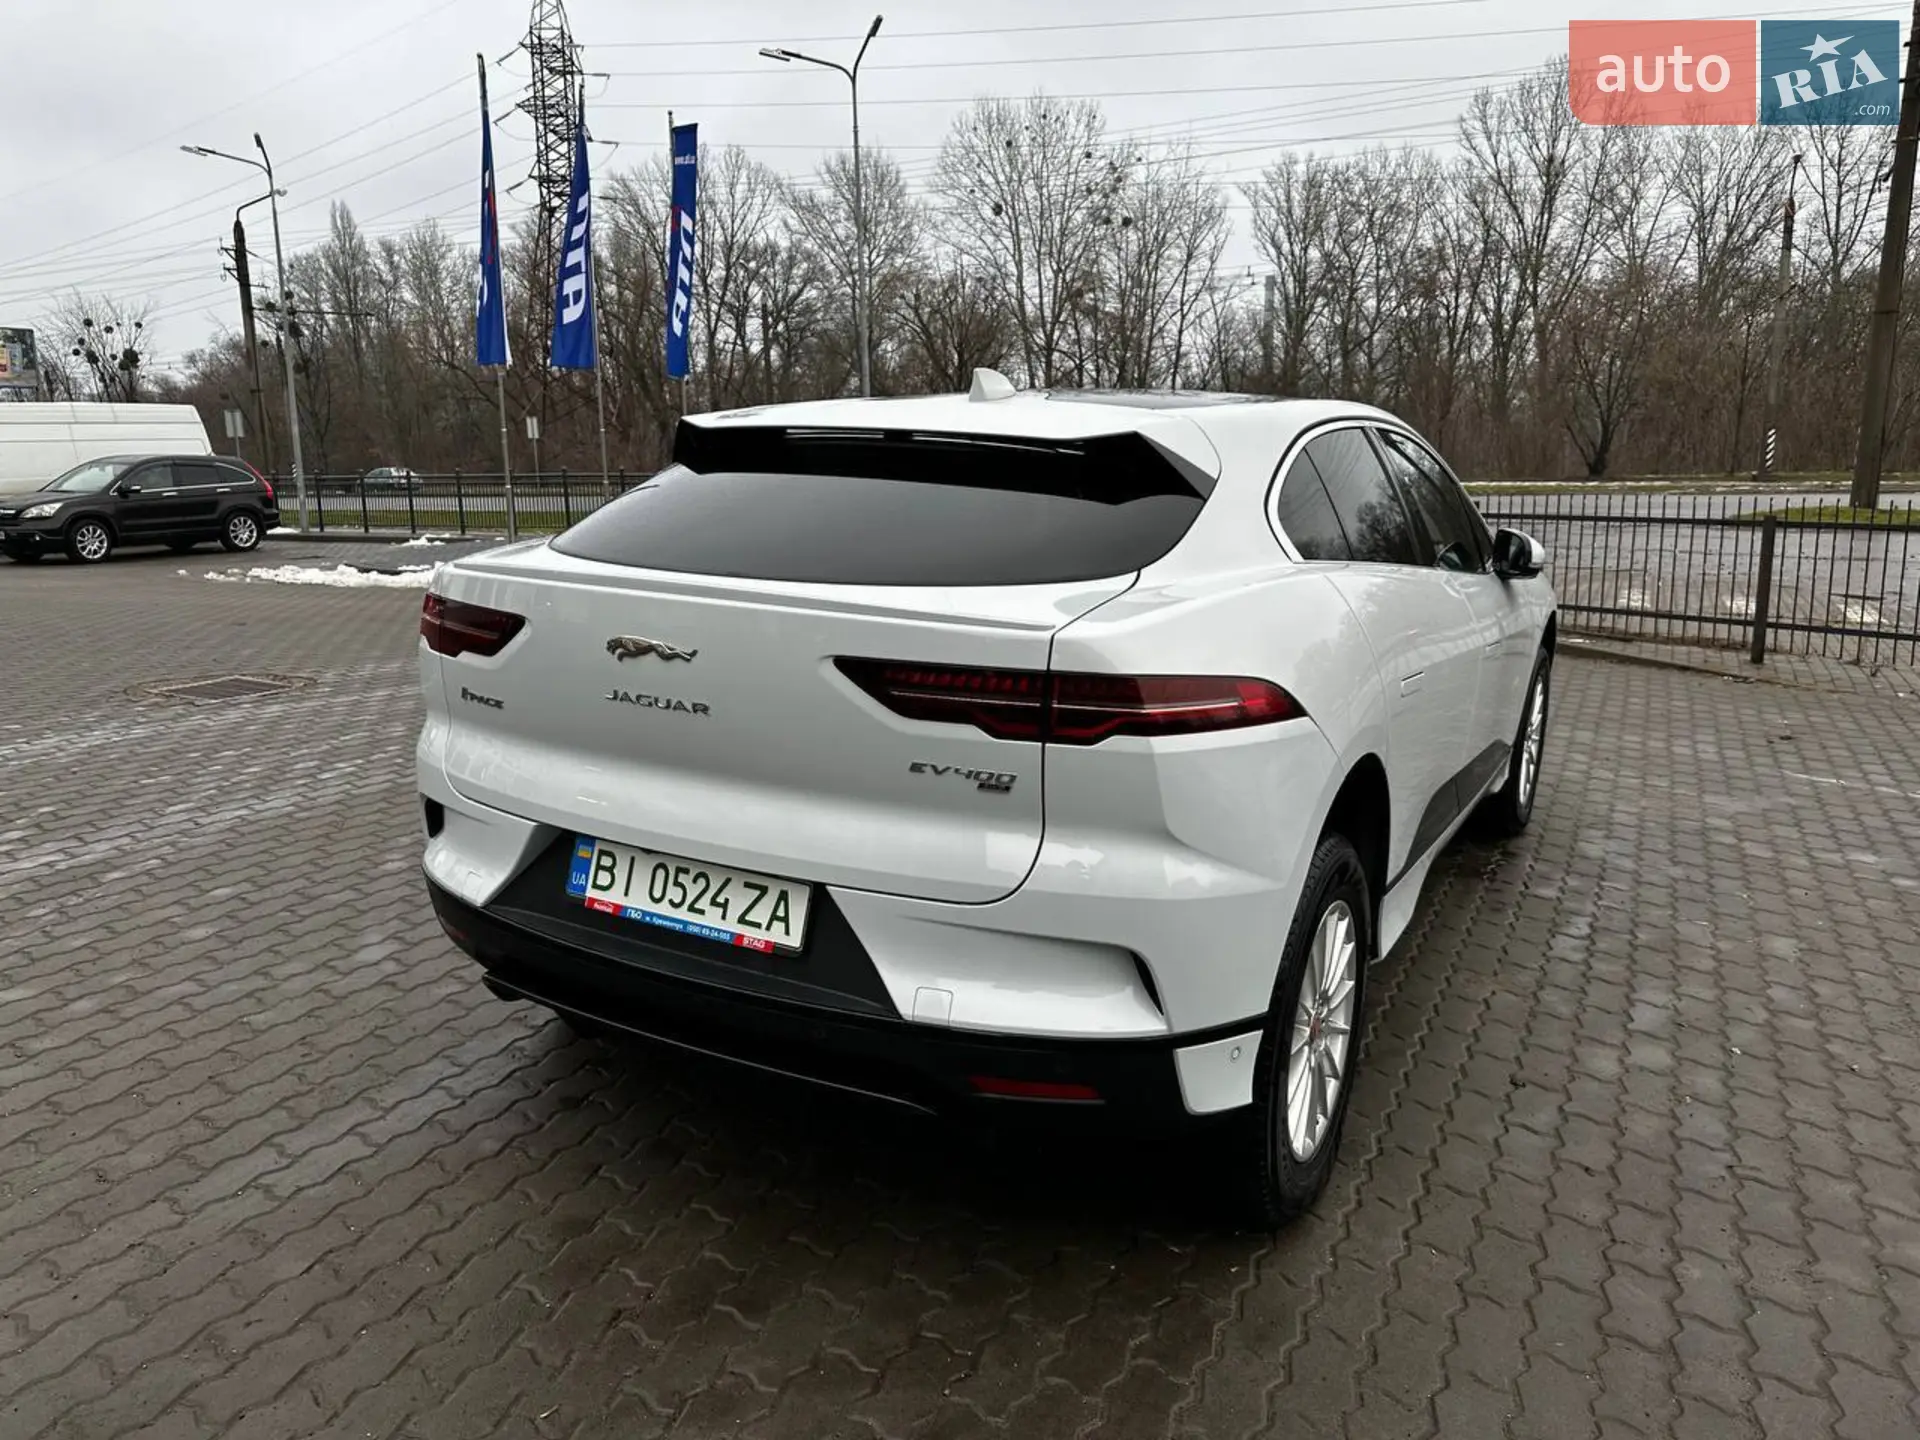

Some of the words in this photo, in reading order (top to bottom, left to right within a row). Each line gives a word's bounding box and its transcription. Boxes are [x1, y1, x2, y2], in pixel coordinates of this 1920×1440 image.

[605, 689, 711, 716] JAGUAR
[572, 871, 586, 886] UA
[591, 848, 635, 897] BI
[649, 862, 732, 921] 0524
[737, 881, 791, 936] ZA
